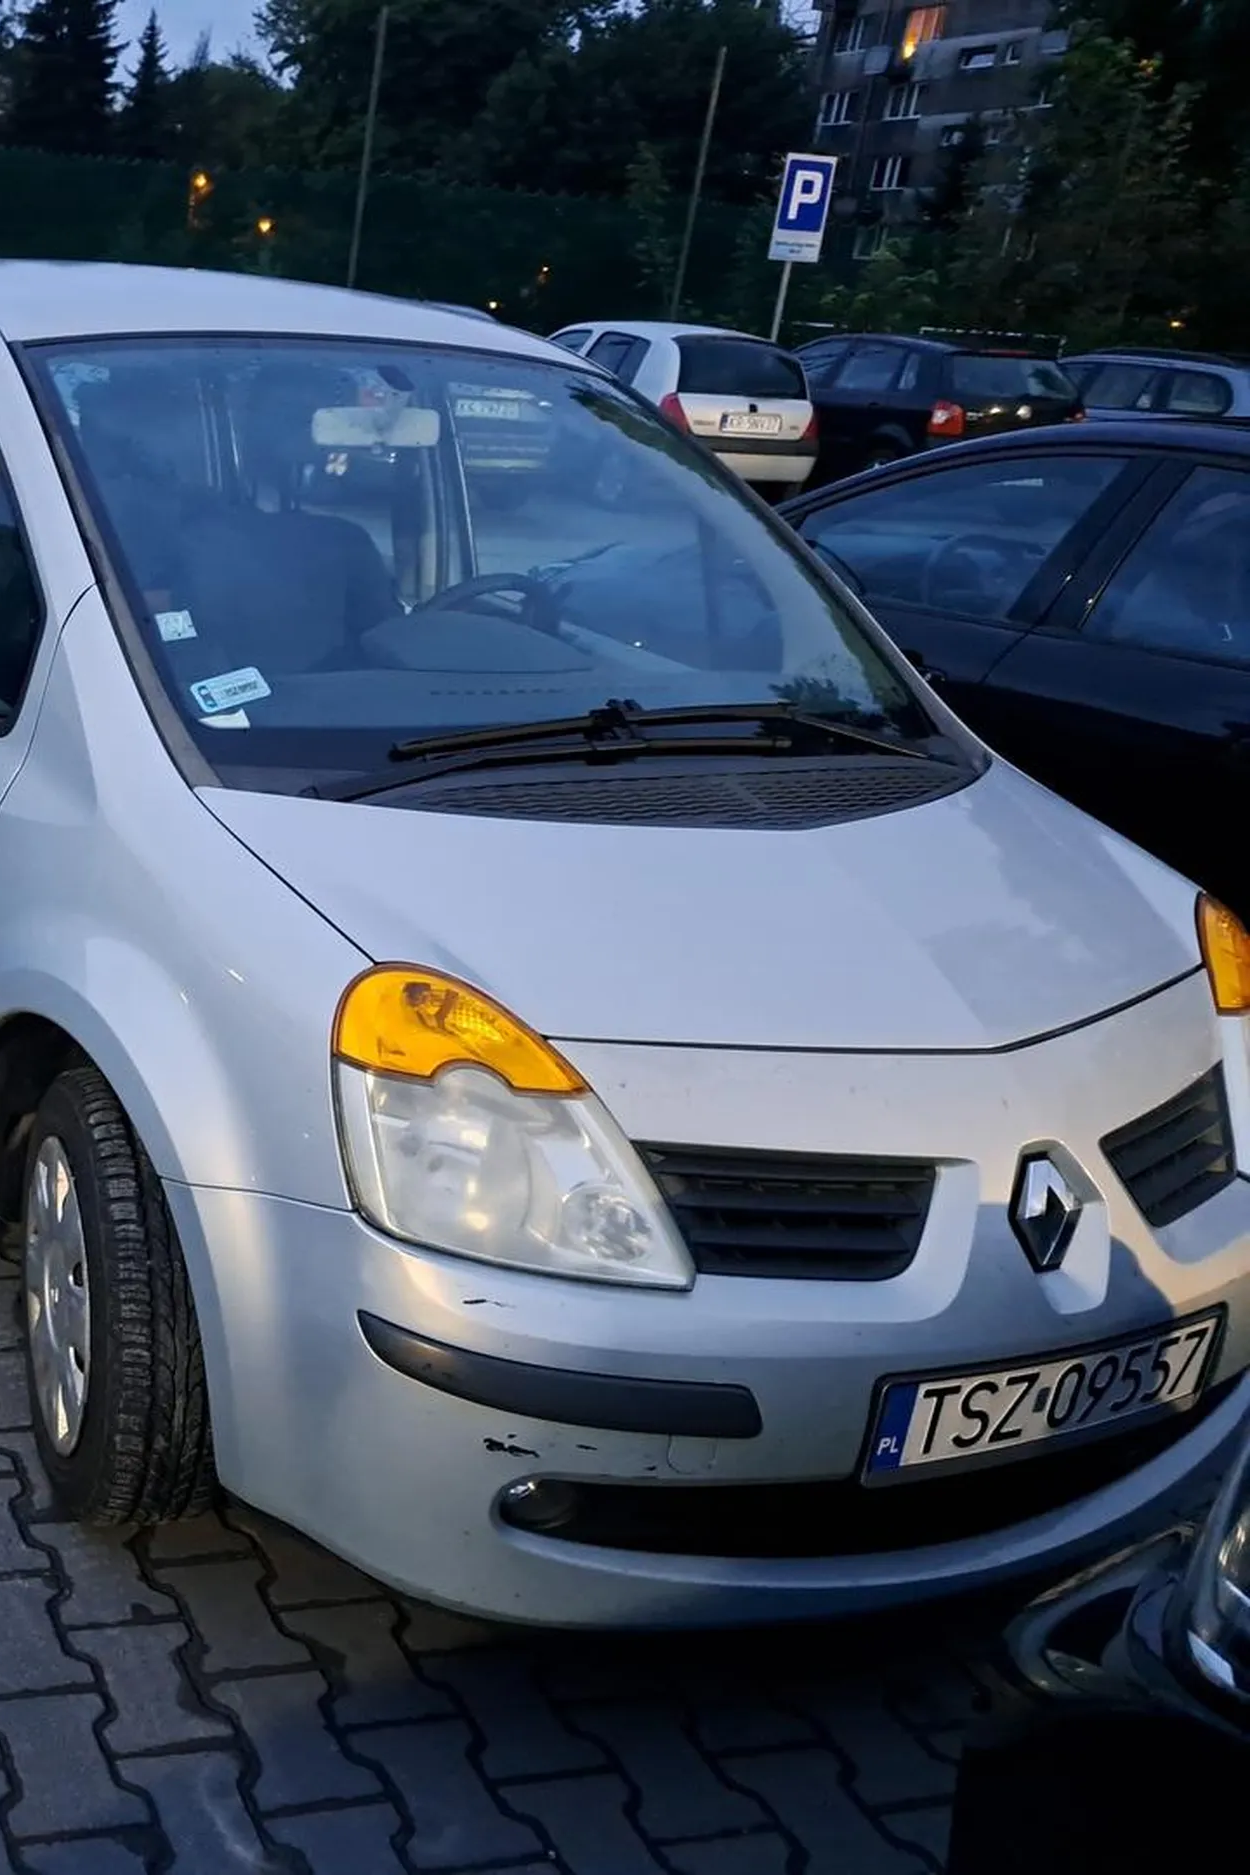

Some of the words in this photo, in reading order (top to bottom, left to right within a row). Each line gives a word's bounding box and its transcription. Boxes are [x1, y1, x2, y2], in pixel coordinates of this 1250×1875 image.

[787, 170, 824, 220] P
[922, 1372, 1040, 1454] TSZ
[1046, 1327, 1209, 1428] 09557
[876, 1436, 899, 1456] PL
